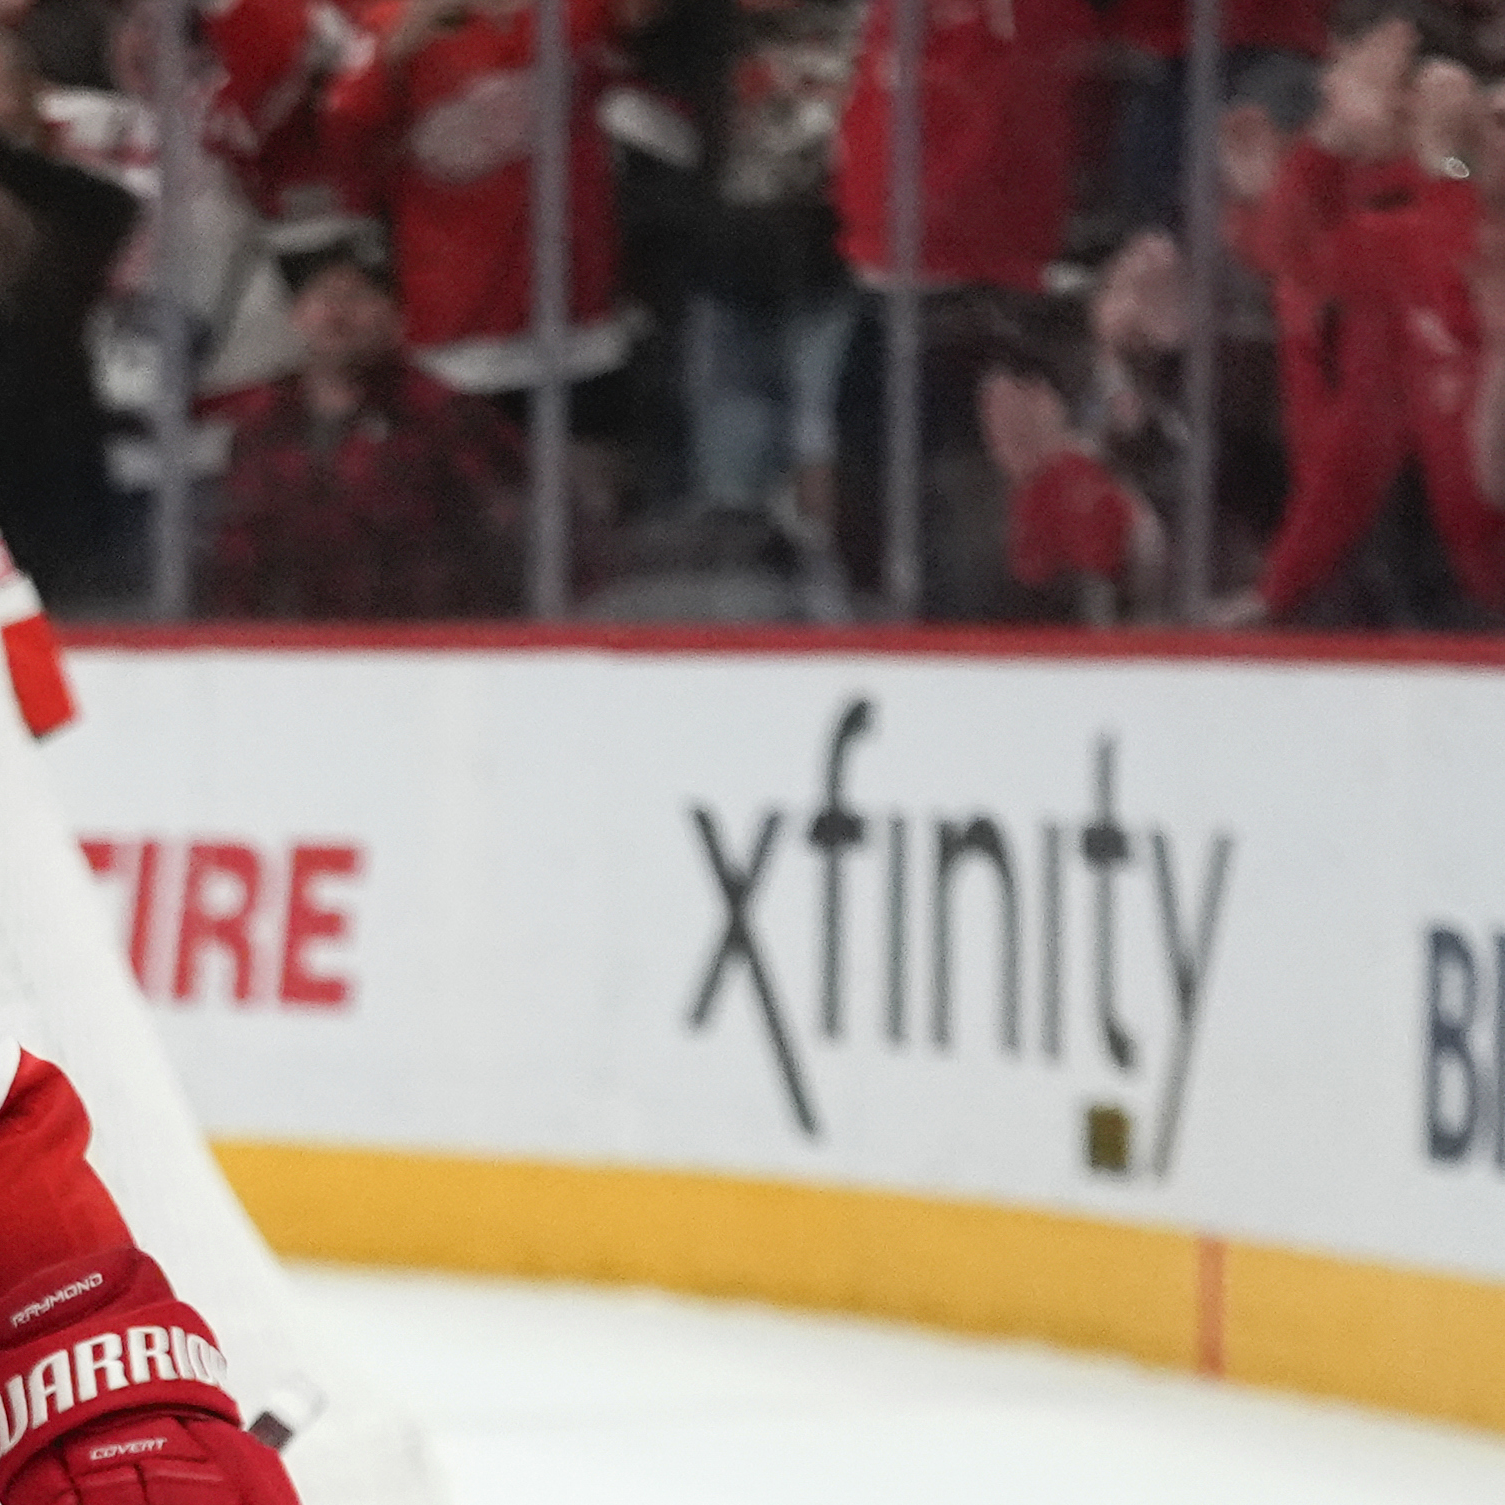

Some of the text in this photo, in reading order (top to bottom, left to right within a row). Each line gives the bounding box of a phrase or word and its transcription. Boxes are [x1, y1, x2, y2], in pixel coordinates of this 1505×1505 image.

[81, 838, 363, 1005] IRE
[689, 700, 1233, 1178] xfinity
[11, 1272, 104, 1328] RAYMOND
[90, 1437, 168, 1460] COVERT
